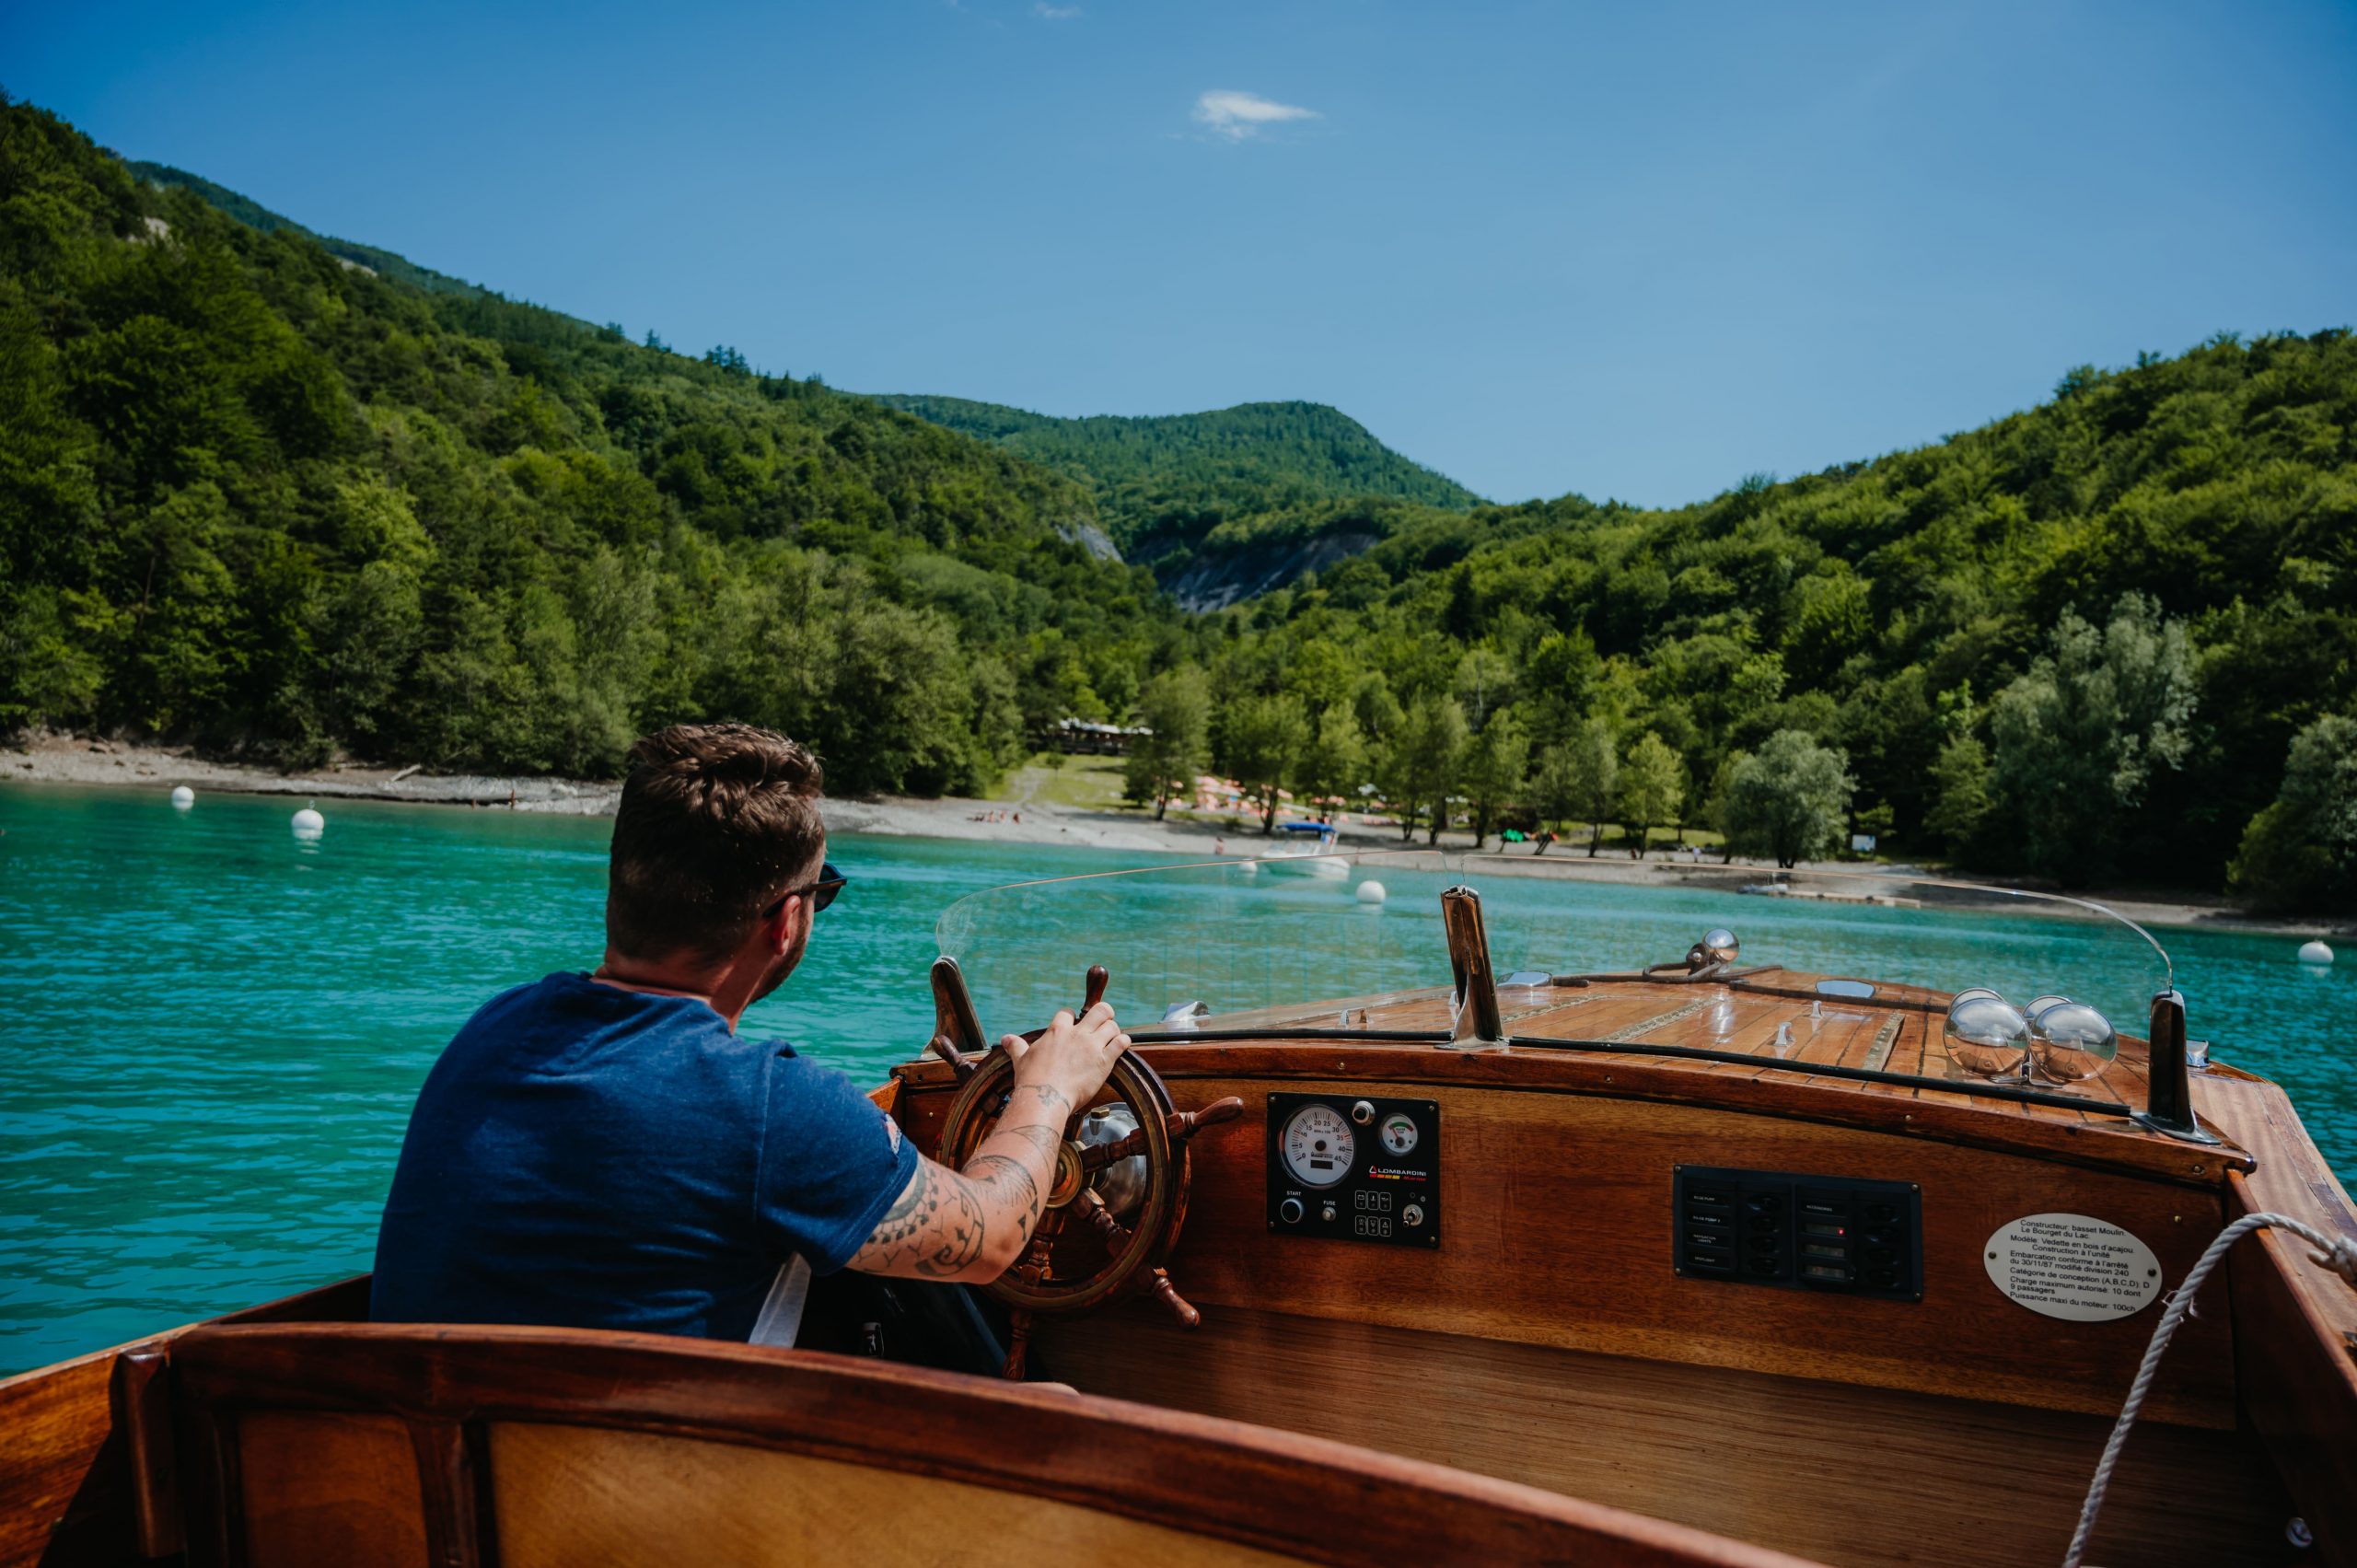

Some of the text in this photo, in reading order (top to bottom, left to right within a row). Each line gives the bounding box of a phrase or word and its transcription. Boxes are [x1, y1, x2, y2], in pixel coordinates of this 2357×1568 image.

[2033, 1227, 2061, 1237] Bourget
[2099, 1228, 2126, 1236] Moulin.
[2042, 1238, 2069, 1246] Vedette
[2032, 1244, 2078, 1254] Construction
[2010, 1250, 2056, 1261] Embarcation
[2058, 1256, 2093, 1265] conforme
[2103, 1261, 2128, 1269] l'arrêté
[2021, 1259, 2052, 1267] 30/11/87
[2055, 1263, 2082, 1271] modifié
[2084, 1266, 2112, 1274] division
[2010, 1267, 2045, 1276] Catégorie
[2059, 1274, 2100, 1283] conception
[2010, 1276, 2037, 1285] Charge
[2039, 1281, 2075, 1289] maximum
[2017, 1285, 2055, 1294] passagers
[2010, 1291, 2047, 1301] Puissance
